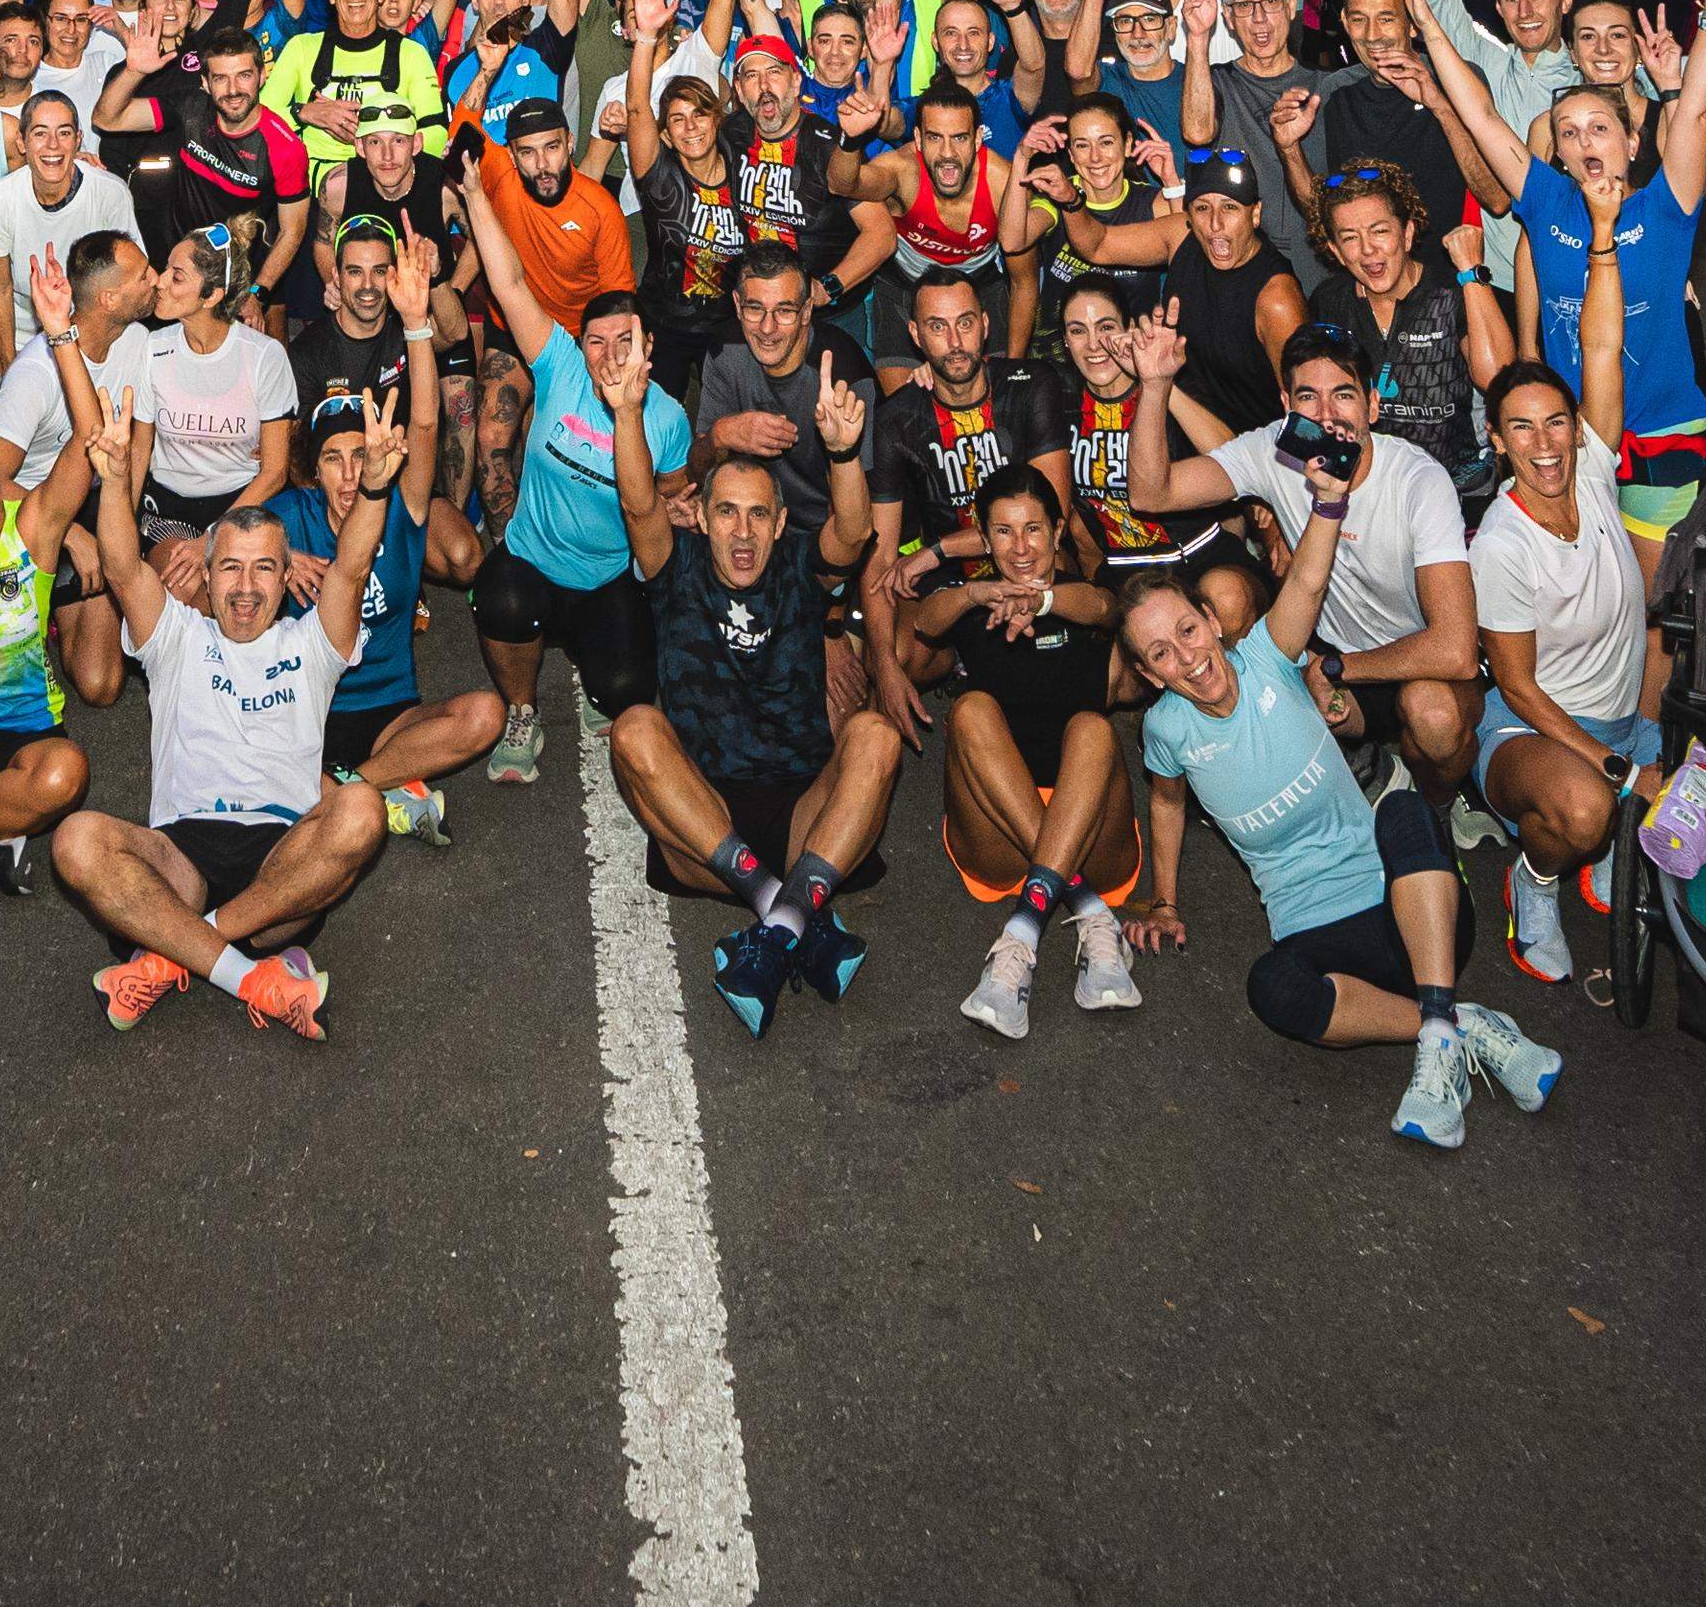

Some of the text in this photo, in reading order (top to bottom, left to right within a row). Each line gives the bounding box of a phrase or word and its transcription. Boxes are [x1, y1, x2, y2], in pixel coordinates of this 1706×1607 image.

[336, 90, 364, 105] RUN
[187, 139, 259, 187] PRORUNNERS
[739, 204, 762, 217] XXIV
[765, 211, 806, 227] EDICIÓN
[687, 234, 710, 248] XXIV
[1053, 259, 1073, 274] HALF
[157, 407, 247, 434] CUELLAR
[1079, 488, 1105, 499] XXIV
[265, 655, 302, 681] 2XU
[210, 674, 296, 713] BAELONA
[1230, 758, 1327, 836] VALENCIA
